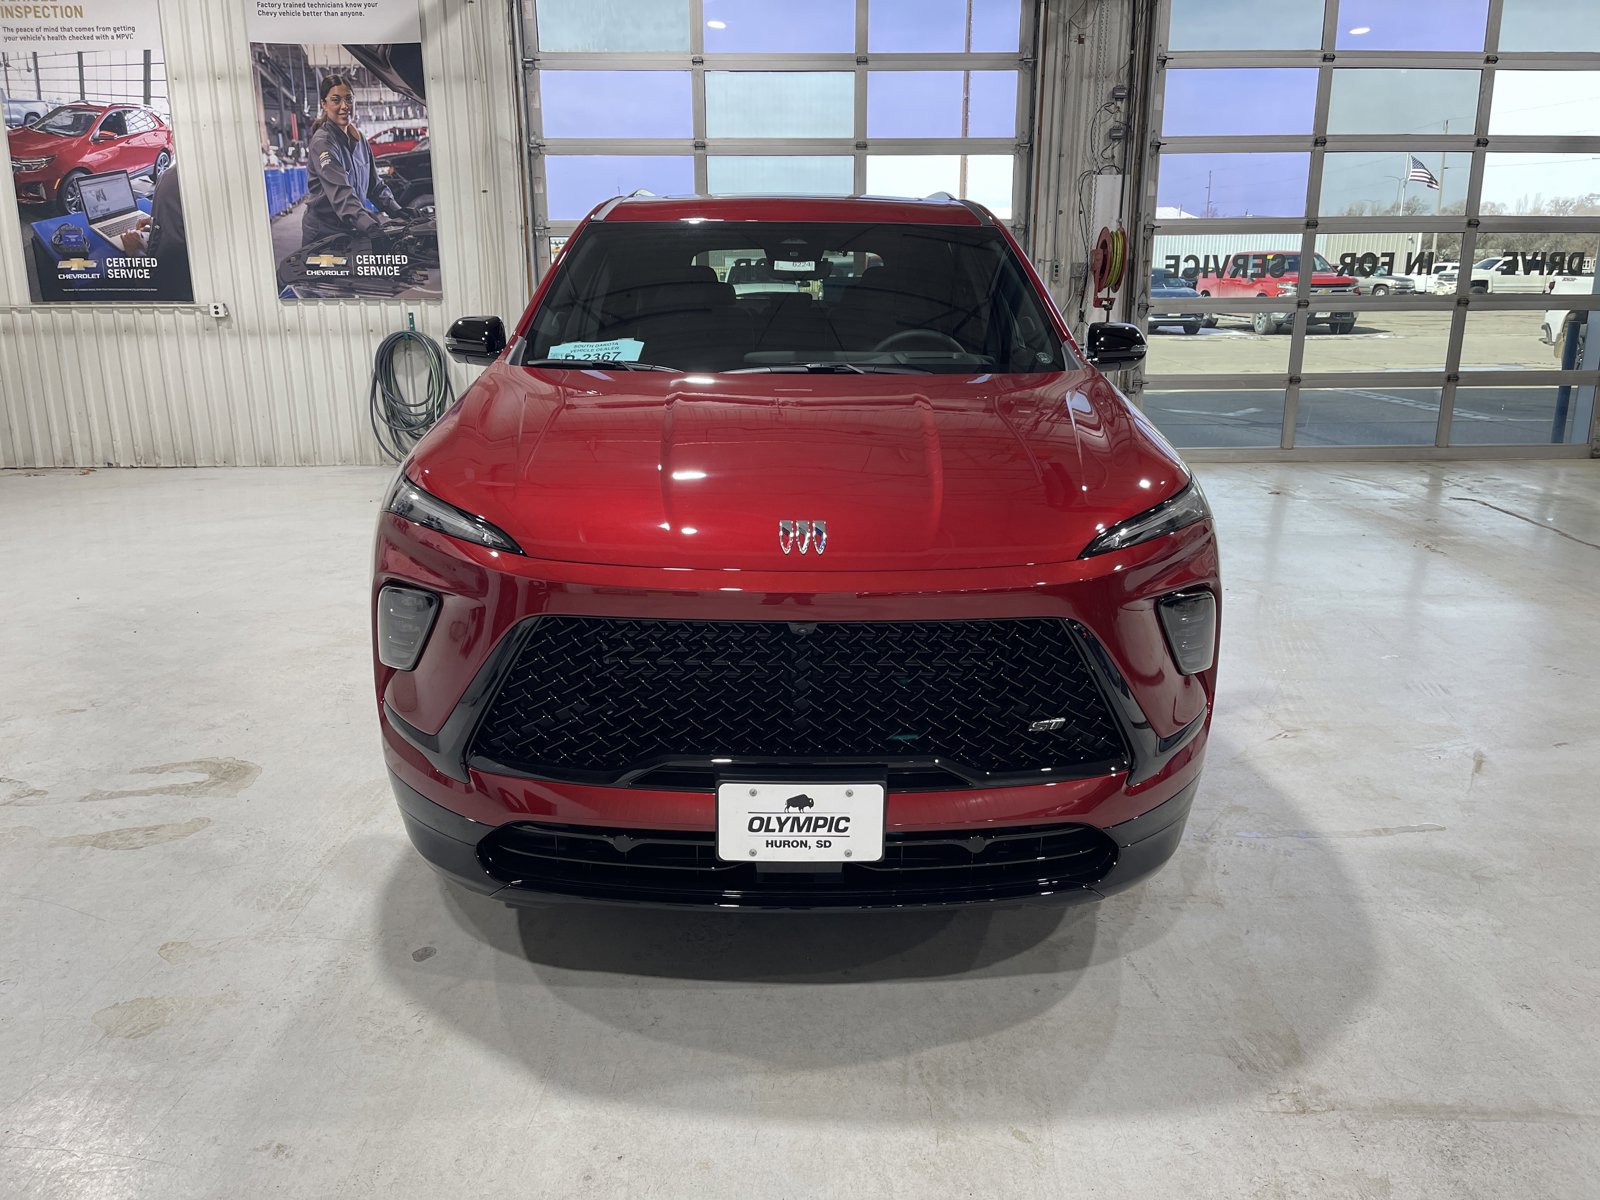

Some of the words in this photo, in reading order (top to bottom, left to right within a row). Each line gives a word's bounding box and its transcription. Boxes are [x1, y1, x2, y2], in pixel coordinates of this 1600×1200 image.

[256, 1, 281, 9] Factory
[0, 5, 84, 19] INSPECTION
[257, 9, 277, 18] Chevy
[112, 25, 136, 33] getting
[106, 257, 158, 268] CERTIFIED
[355, 254, 408, 265] CERTIFIED
[107, 269, 151, 279] SERVICE
[357, 266, 400, 276] SERVICE
[747, 816, 851, 833] OLYMPIC
[765, 839, 812, 850] HURON,
[815, 839, 832, 848] SD
